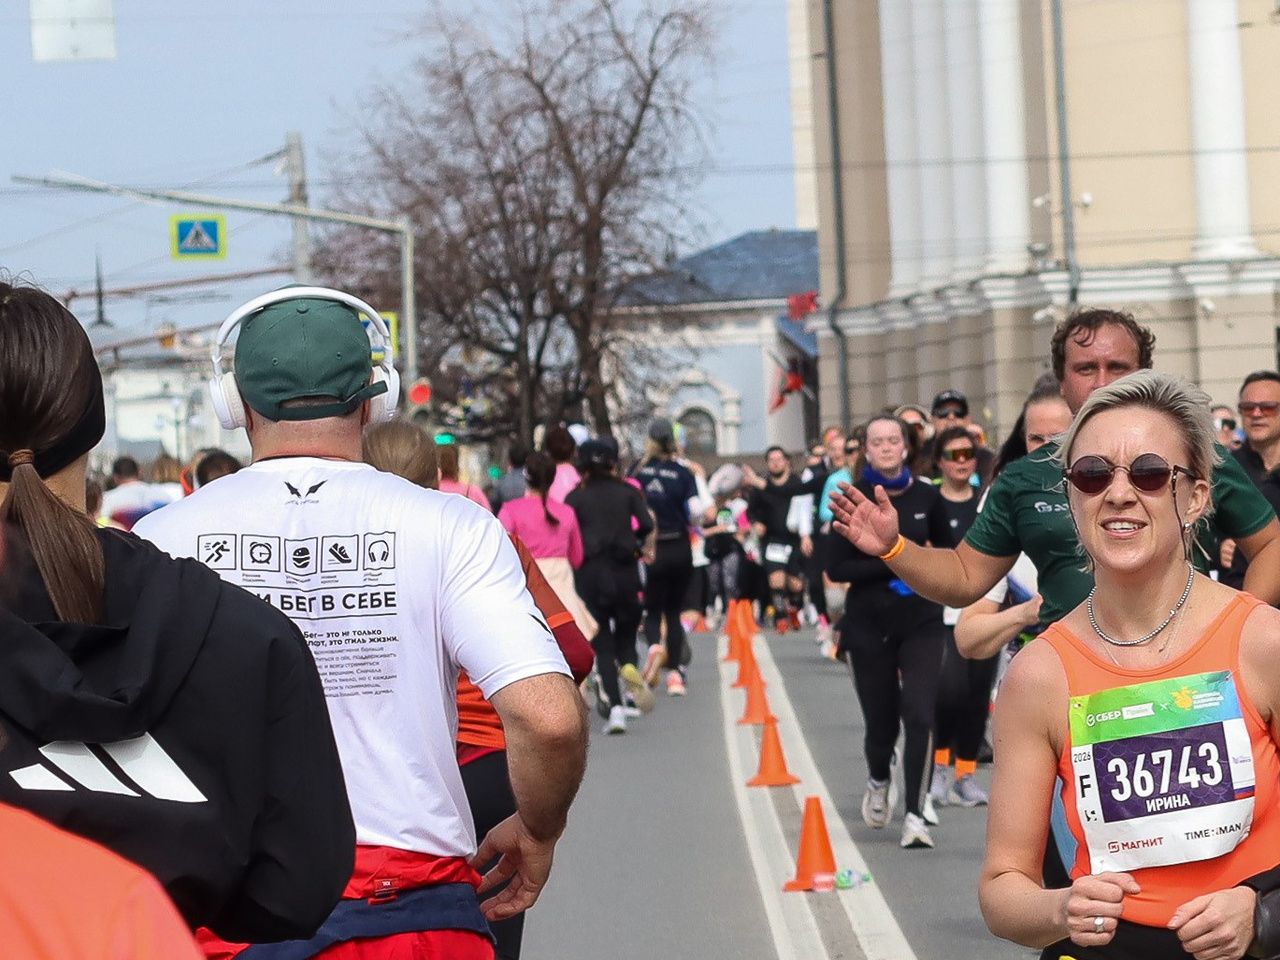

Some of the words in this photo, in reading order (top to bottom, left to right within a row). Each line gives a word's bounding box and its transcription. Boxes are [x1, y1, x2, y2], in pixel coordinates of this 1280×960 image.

[281, 594, 317, 612] БЕГ
[322, 595, 335, 611] В
[342, 591, 397, 610] СЕБЕ
[352, 629, 382, 637] только
[1096, 711, 1121, 722] СБЕР
[1073, 751, 1091, 763] 2026
[1107, 742, 1223, 802] 36743
[1079, 775, 1091, 798] F
[1145, 793, 1191, 813] ИРИНА
[1121, 837, 1164, 851] МАГНИТ
